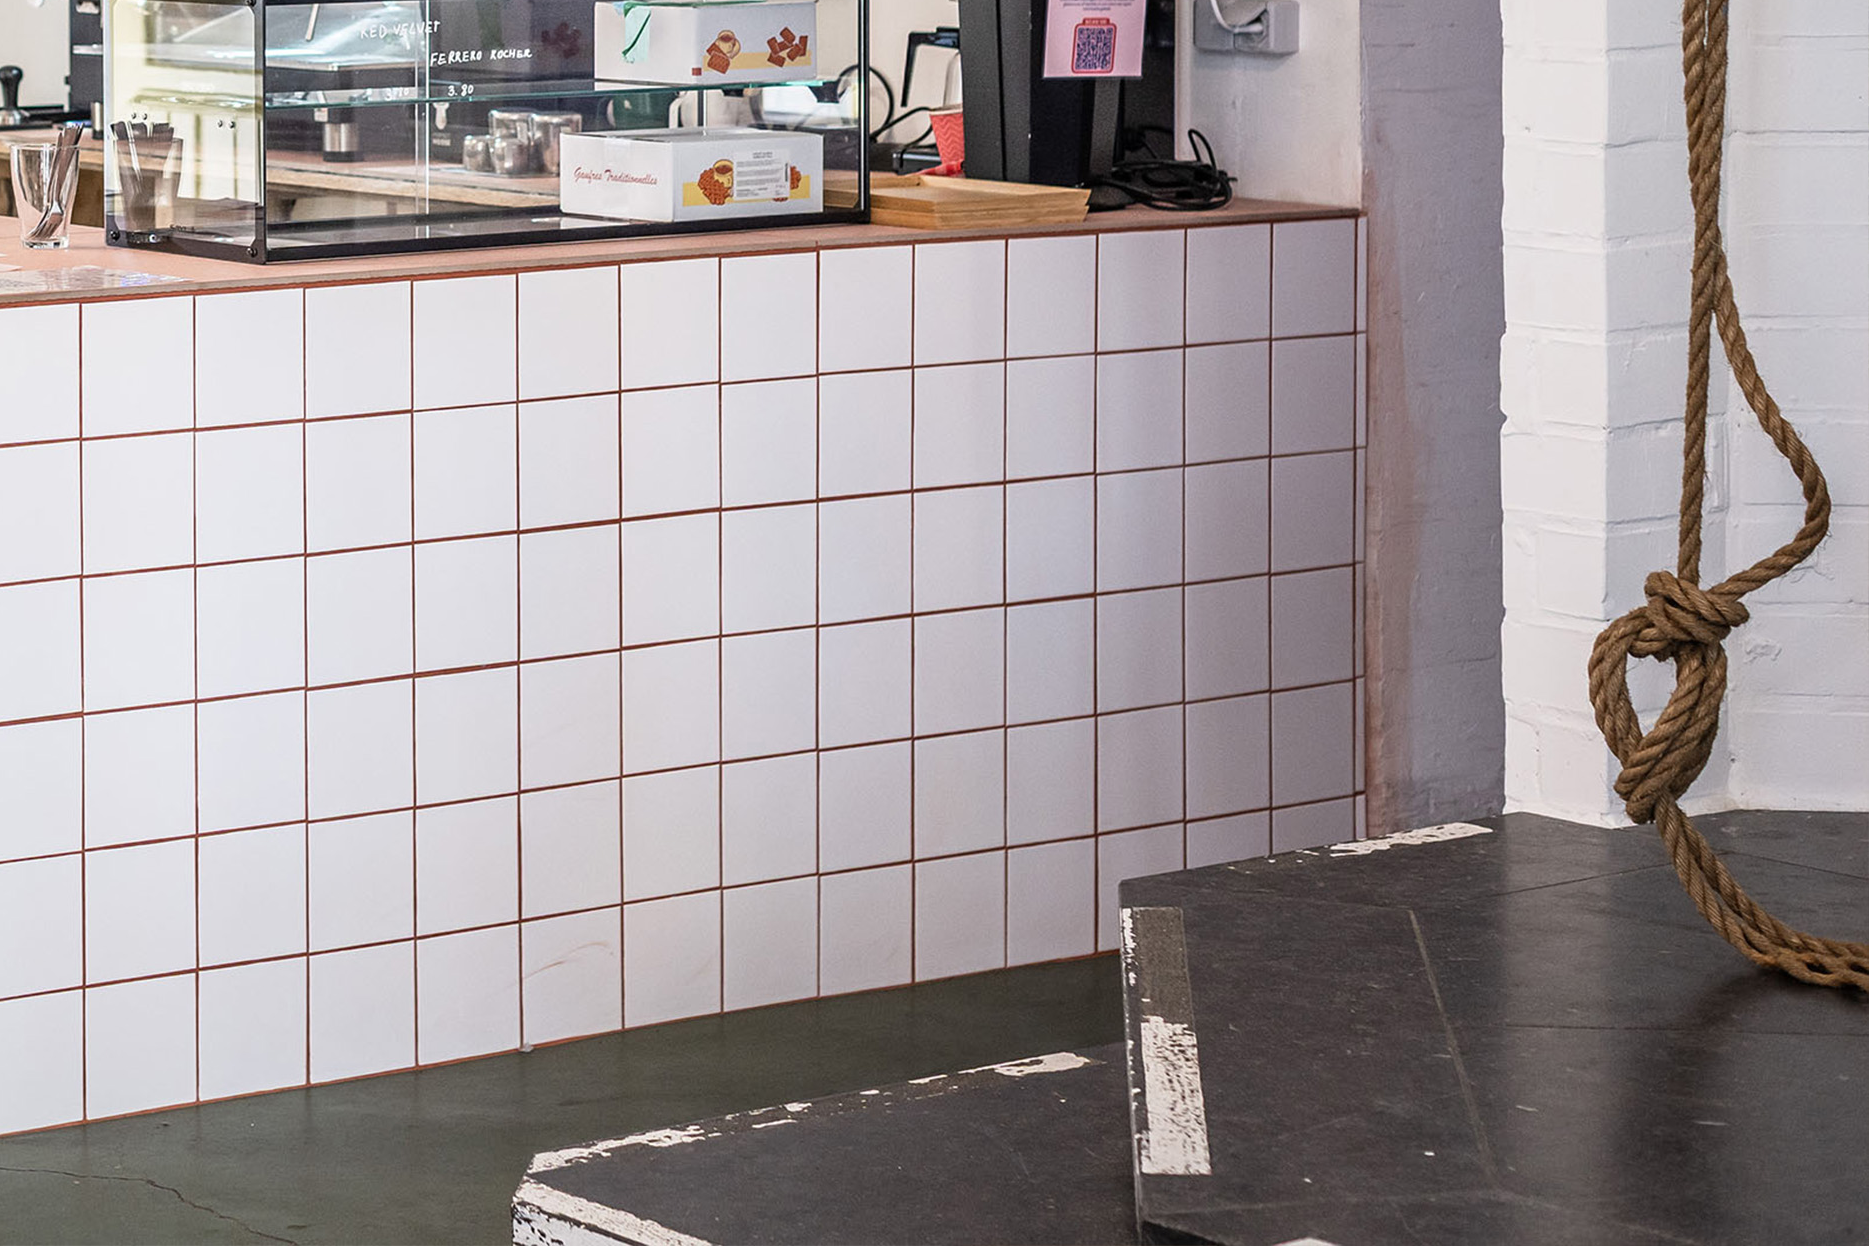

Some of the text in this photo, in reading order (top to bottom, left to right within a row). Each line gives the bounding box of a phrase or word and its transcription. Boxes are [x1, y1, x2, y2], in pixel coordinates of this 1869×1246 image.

[430, 48, 532, 67] FERRERO ROCHER
[573, 166, 658, 186] Gaufres Traditionnelles
